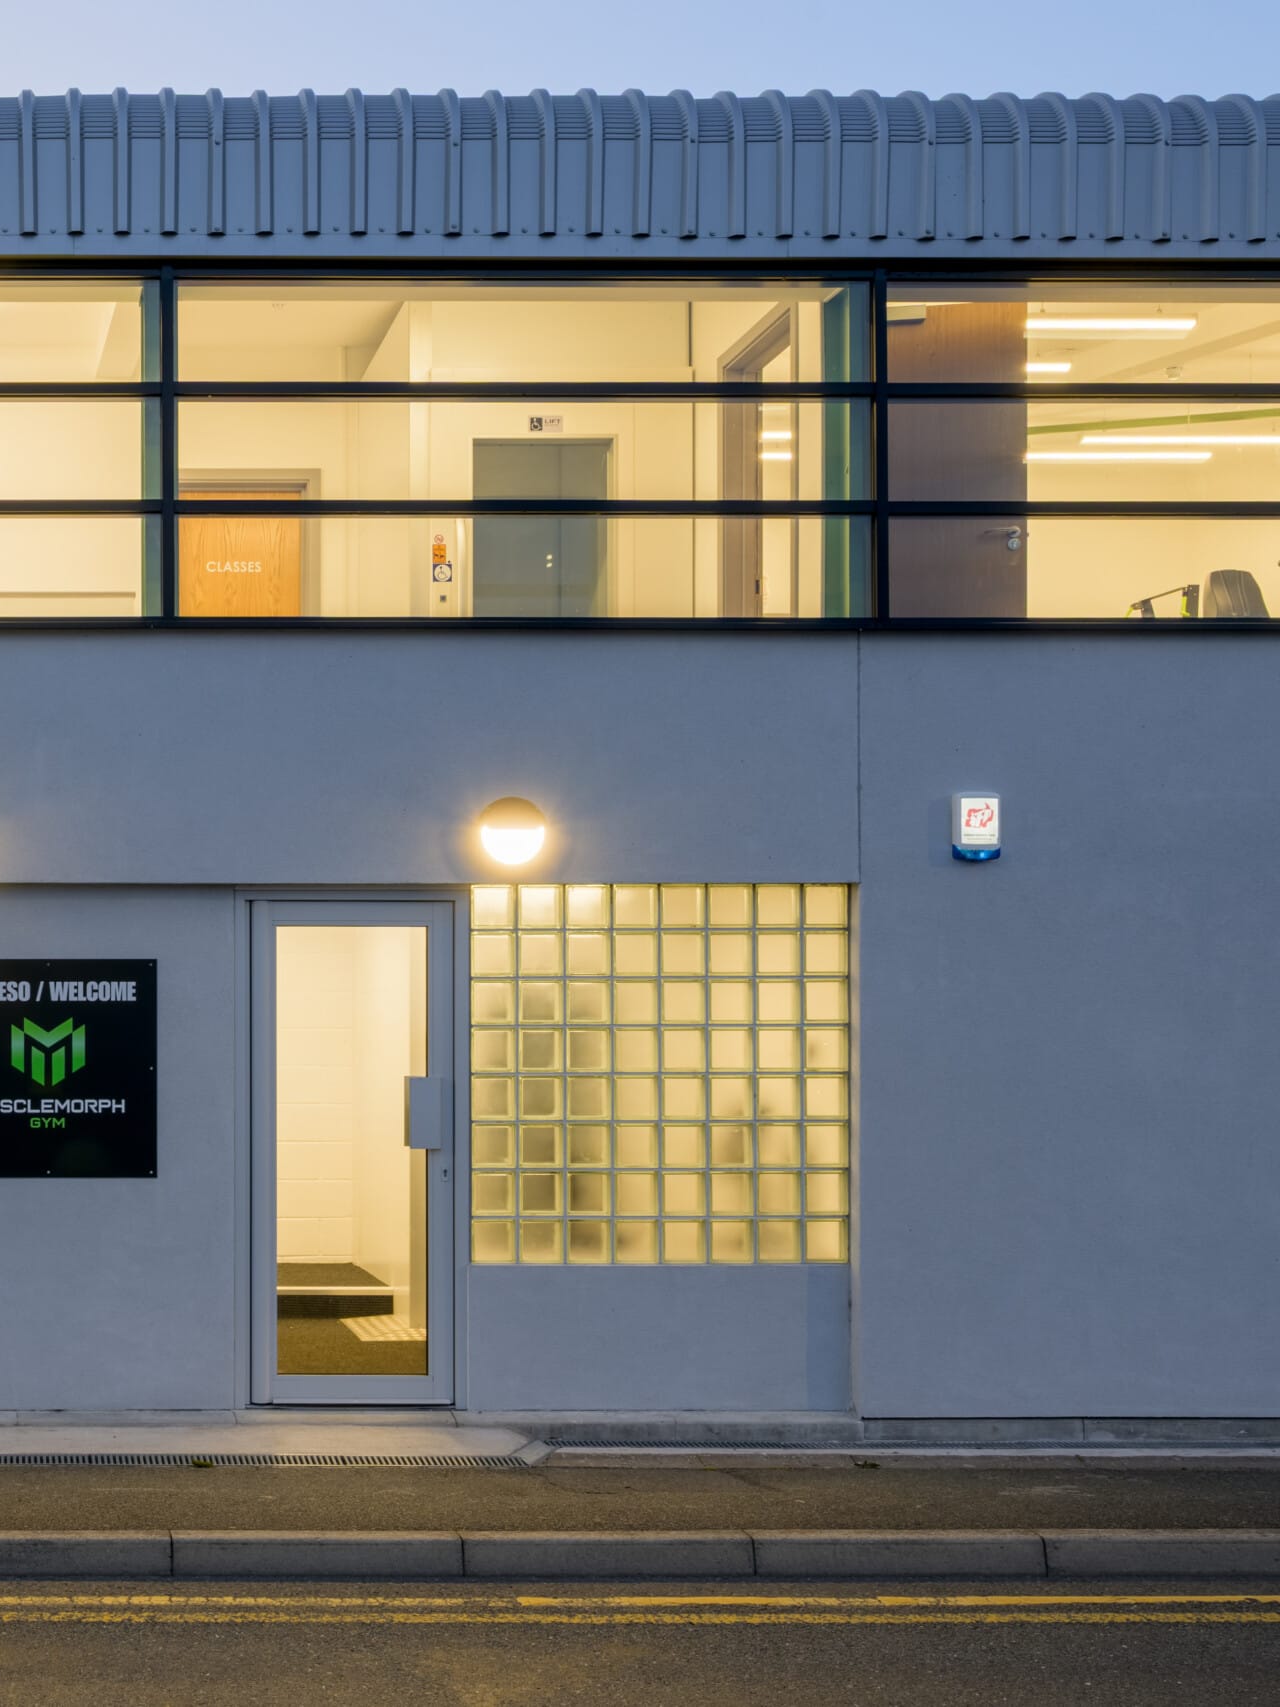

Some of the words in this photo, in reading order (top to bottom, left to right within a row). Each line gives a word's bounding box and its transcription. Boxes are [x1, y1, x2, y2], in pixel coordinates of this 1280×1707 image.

[206, 561, 262, 573] CLASSES
[35, 981, 45, 1002] /
[49, 981, 137, 1002] WELCOME
[30, 1117, 66, 1129] GYM
